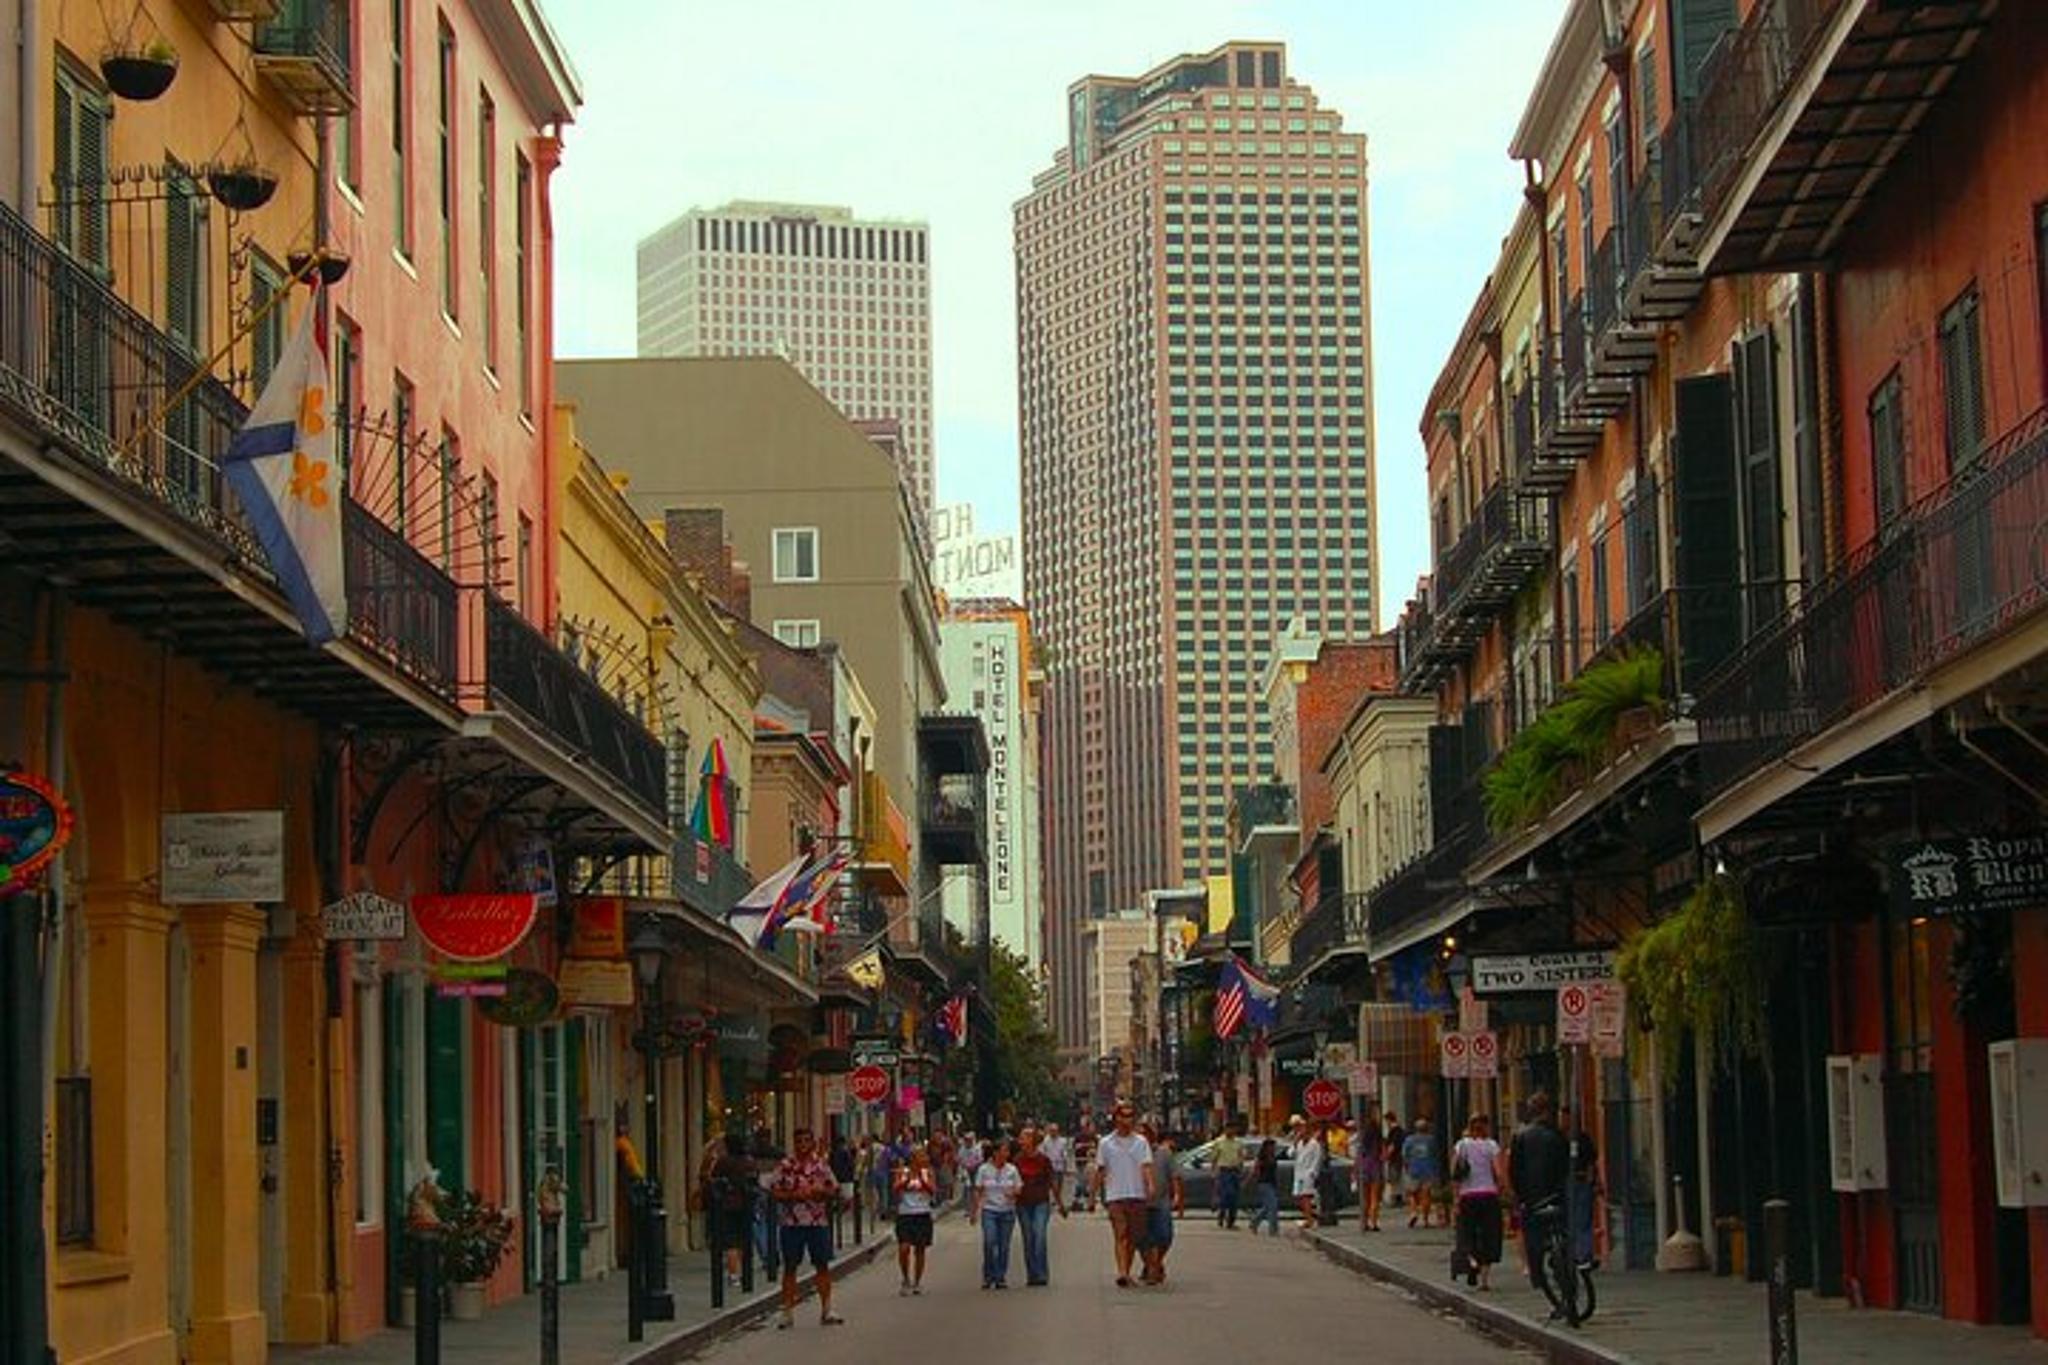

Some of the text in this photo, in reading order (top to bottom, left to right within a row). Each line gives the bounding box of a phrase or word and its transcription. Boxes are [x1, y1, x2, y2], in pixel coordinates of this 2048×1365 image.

[991, 645, 1010, 891] HOTEL MONTELEONE
[1479, 965, 1614, 986] TWO SISTERS
[855, 1077, 886, 1093] STOP
[1308, 1091, 1337, 1107] STOP
